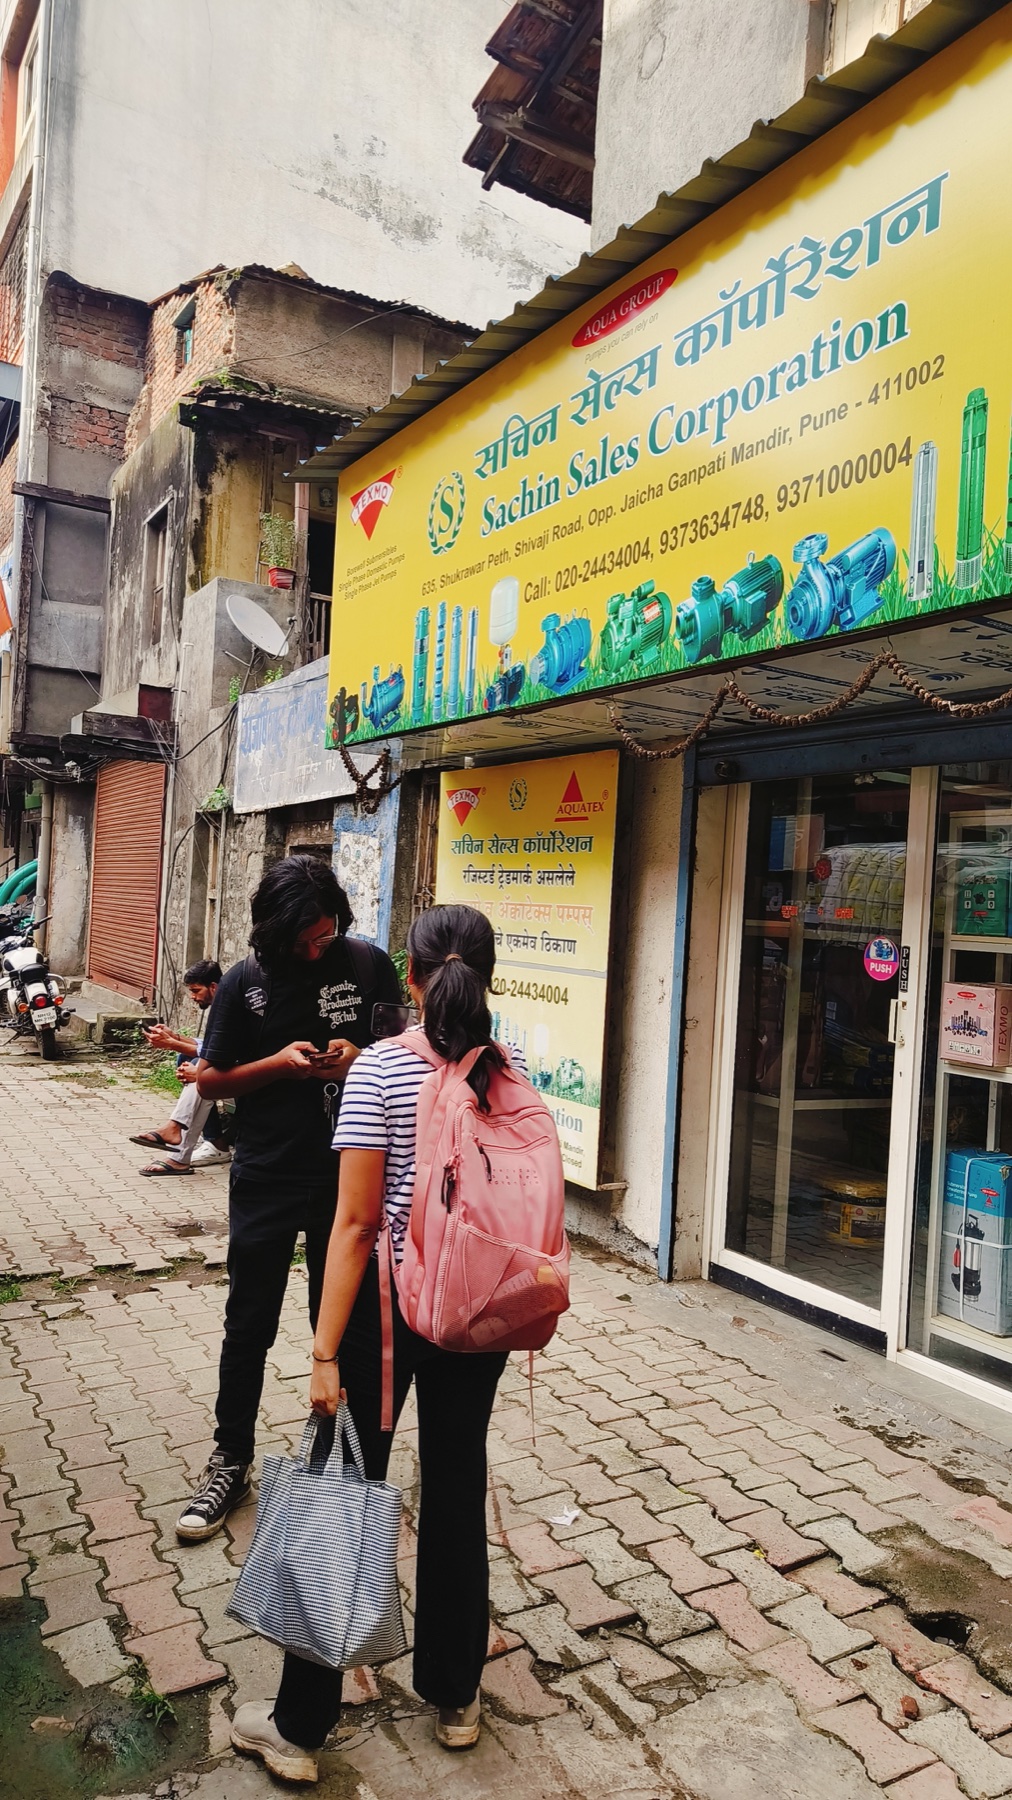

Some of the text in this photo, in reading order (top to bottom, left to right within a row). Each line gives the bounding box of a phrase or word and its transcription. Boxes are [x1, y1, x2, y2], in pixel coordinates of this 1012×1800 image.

[583, 277, 664, 341] AQUA GROUP
[474, 170, 949, 480] सचिन सेल्स कॉर्पोरेशन
[585, 312, 659, 364] Pumps you can rely on
[481, 300, 910, 537] Sachin Sales Corporation
[421, 579, 438, 597] 635,
[439, 559, 486, 590] Shukrawar
[487, 548, 512, 570] Peth,
[514, 528, 550, 559] Shivaji
[551, 514, 585, 542] Road,
[587, 504, 617, 527] Opp.
[620, 482, 663, 513] Jaicha
[668, 452, 726, 493] Ganpati
[730, 426, 794, 467] Mandir,
[799, 402, 848, 437] Pune
[867, 354, 946, 407] 411002
[355, 485, 388, 515] TEXMO
[523, 436, 913, 604] Call: 020-24434004, 9373634748, 9371000004
[338, 578, 352, 593] Single
[352, 572, 366, 588] Phase
[388, 553, 405, 570] Pumps
[344, 587, 358, 601] Single
[358, 581, 372, 595] Phase
[380, 569, 398, 585] Pumps
[450, 790, 477, 806] TEXMO
[557, 801, 605, 816] AQUATEX
[451, 830, 594, 854] सचिन सेल्स कॉर्पोरेशन
[536, 864, 576, 886] असलेले
[506, 929, 538, 953] एकमेव
[541, 931, 577, 955] ठिकाण
[869, 962, 893, 974] PUSH
[901, 948, 909, 991] PUSH
[318, 994, 363, 1017] Productive
[320, 980, 358, 1000] Counter
[491, 977, 569, 1006] 20-24434004
[998, 1005, 1009, 1053] TEXMO
